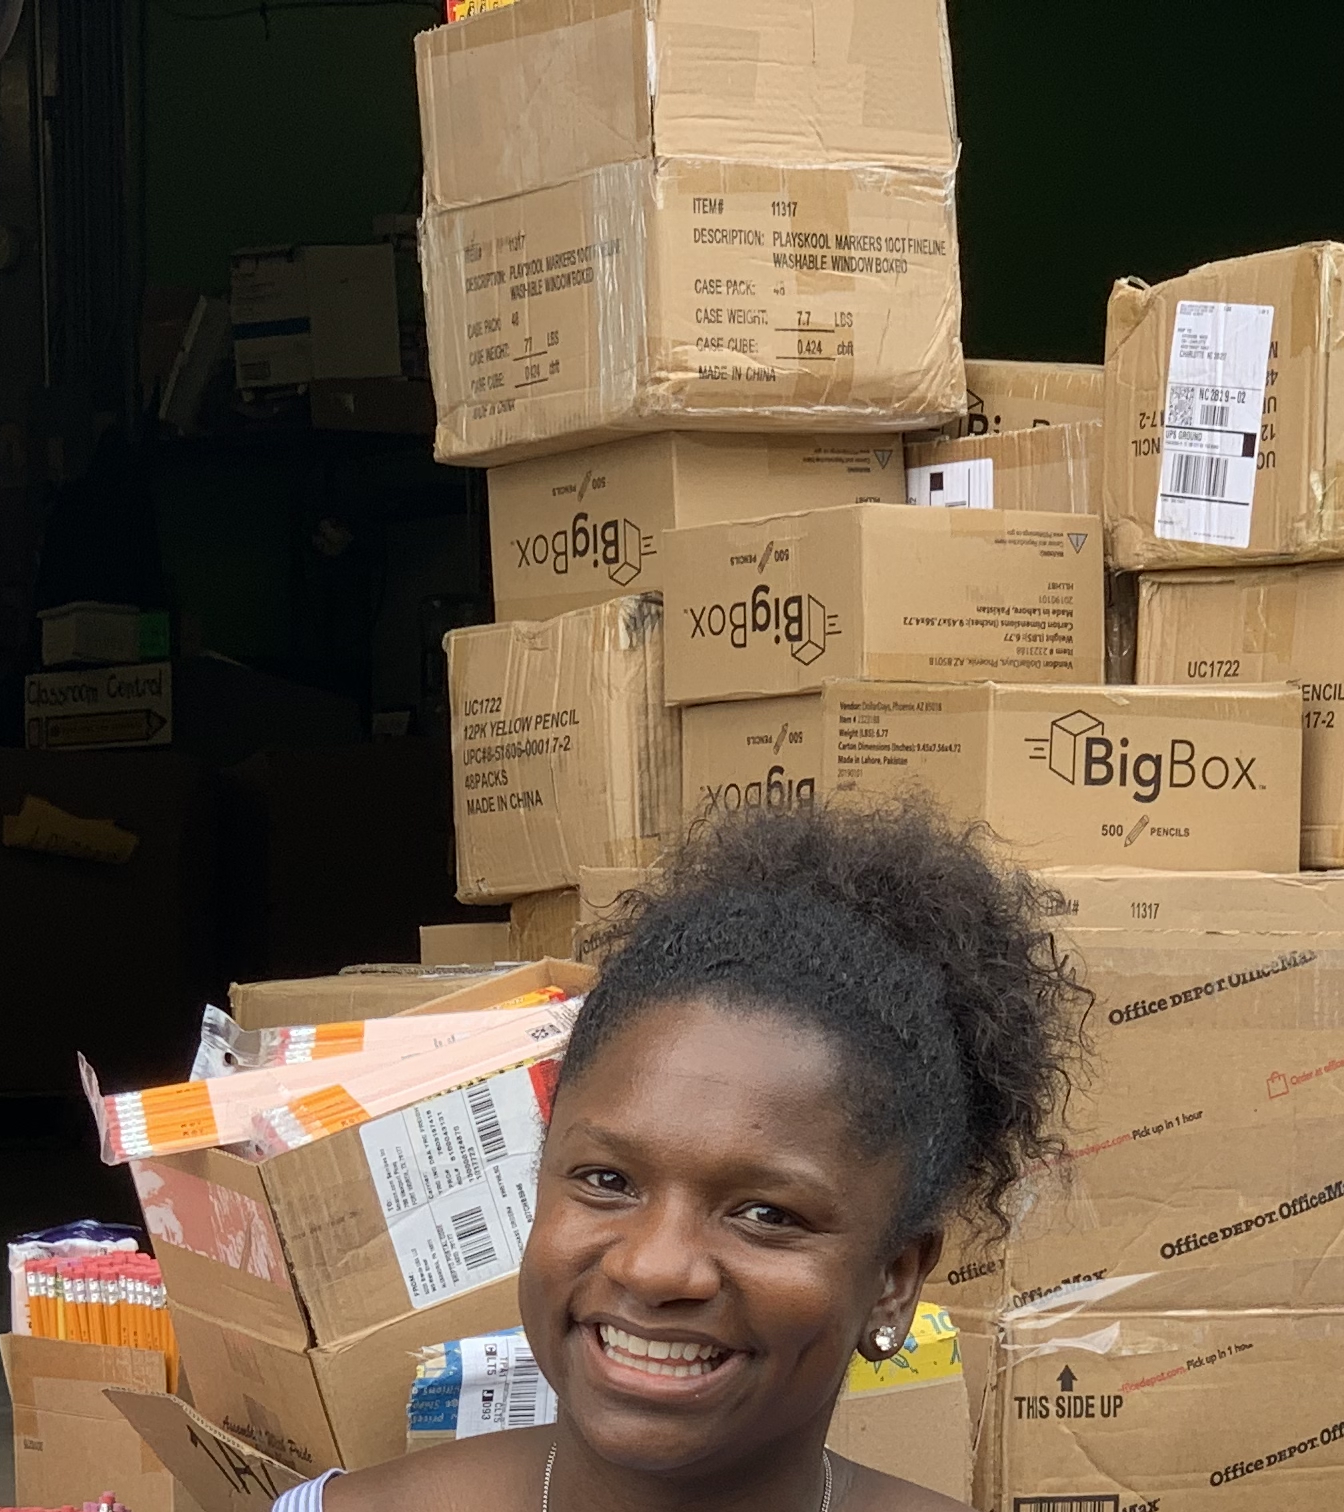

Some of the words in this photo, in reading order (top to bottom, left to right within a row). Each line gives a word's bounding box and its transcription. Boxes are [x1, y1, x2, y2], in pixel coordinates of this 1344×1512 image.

[693, 198, 724, 214] ITEM#
[771, 201, 797, 217] 11317
[694, 228, 765, 246] DESCRIPTION:
[773, 231, 831, 250] PLAYSKOOL
[835, 234, 882, 252] MARKERS
[908, 238, 946, 256] FINELINE
[773, 253, 827, 270] WASHABLE
[831, 256, 874, 273] WINDOW
[694, 279, 722, 295] CASE
[695, 309, 723, 324] CASE
[835, 311, 853, 328] LBS
[696, 337, 723, 352] CASE
[797, 340, 823, 355] 0.424
[698, 365, 727, 381] MADE
[731, 366, 742, 381] IN
[745, 367, 776, 382] CHINA
[516, 512, 620, 574] BigBox
[689, 584, 803, 648] BigBox
[1187, 660, 1241, 678] UC1722
[107, 668, 162, 699] Central
[464, 697, 502, 716] UC1722
[464, 724, 487, 741] 12PK
[490, 715, 533, 736] YELLOW
[535, 709, 579, 730] PENCIL
[465, 769, 508, 790] 48PACKS
[1084, 737, 1256, 803] BigBox
[467, 796, 495, 815] MADE
[497, 794, 508, 811] IN
[510, 789, 544, 811] CHINA
[1101, 824, 1123, 837] 500
[1150, 827, 1190, 838] PENCILS
[1131, 902, 1159, 919] 11317
[1108, 995, 1169, 1026] Office
[1132, 1127, 1151, 1140] Pick
[1151, 1125, 1164, 1135] up
[1182, 1111, 1203, 1124] hour
[1160, 1228, 1219, 1261] Office
[947, 1261, 996, 1286] Office
[1186, 1356, 1205, 1370] Pick
[1205, 1353, 1217, 1365] up
[1014, 1396, 1050, 1419] THIS
[1055, 1396, 1095, 1418] SIDE
[1100, 1395, 1123, 1418] UP
[1209, 1458, 1264, 1488] Office
